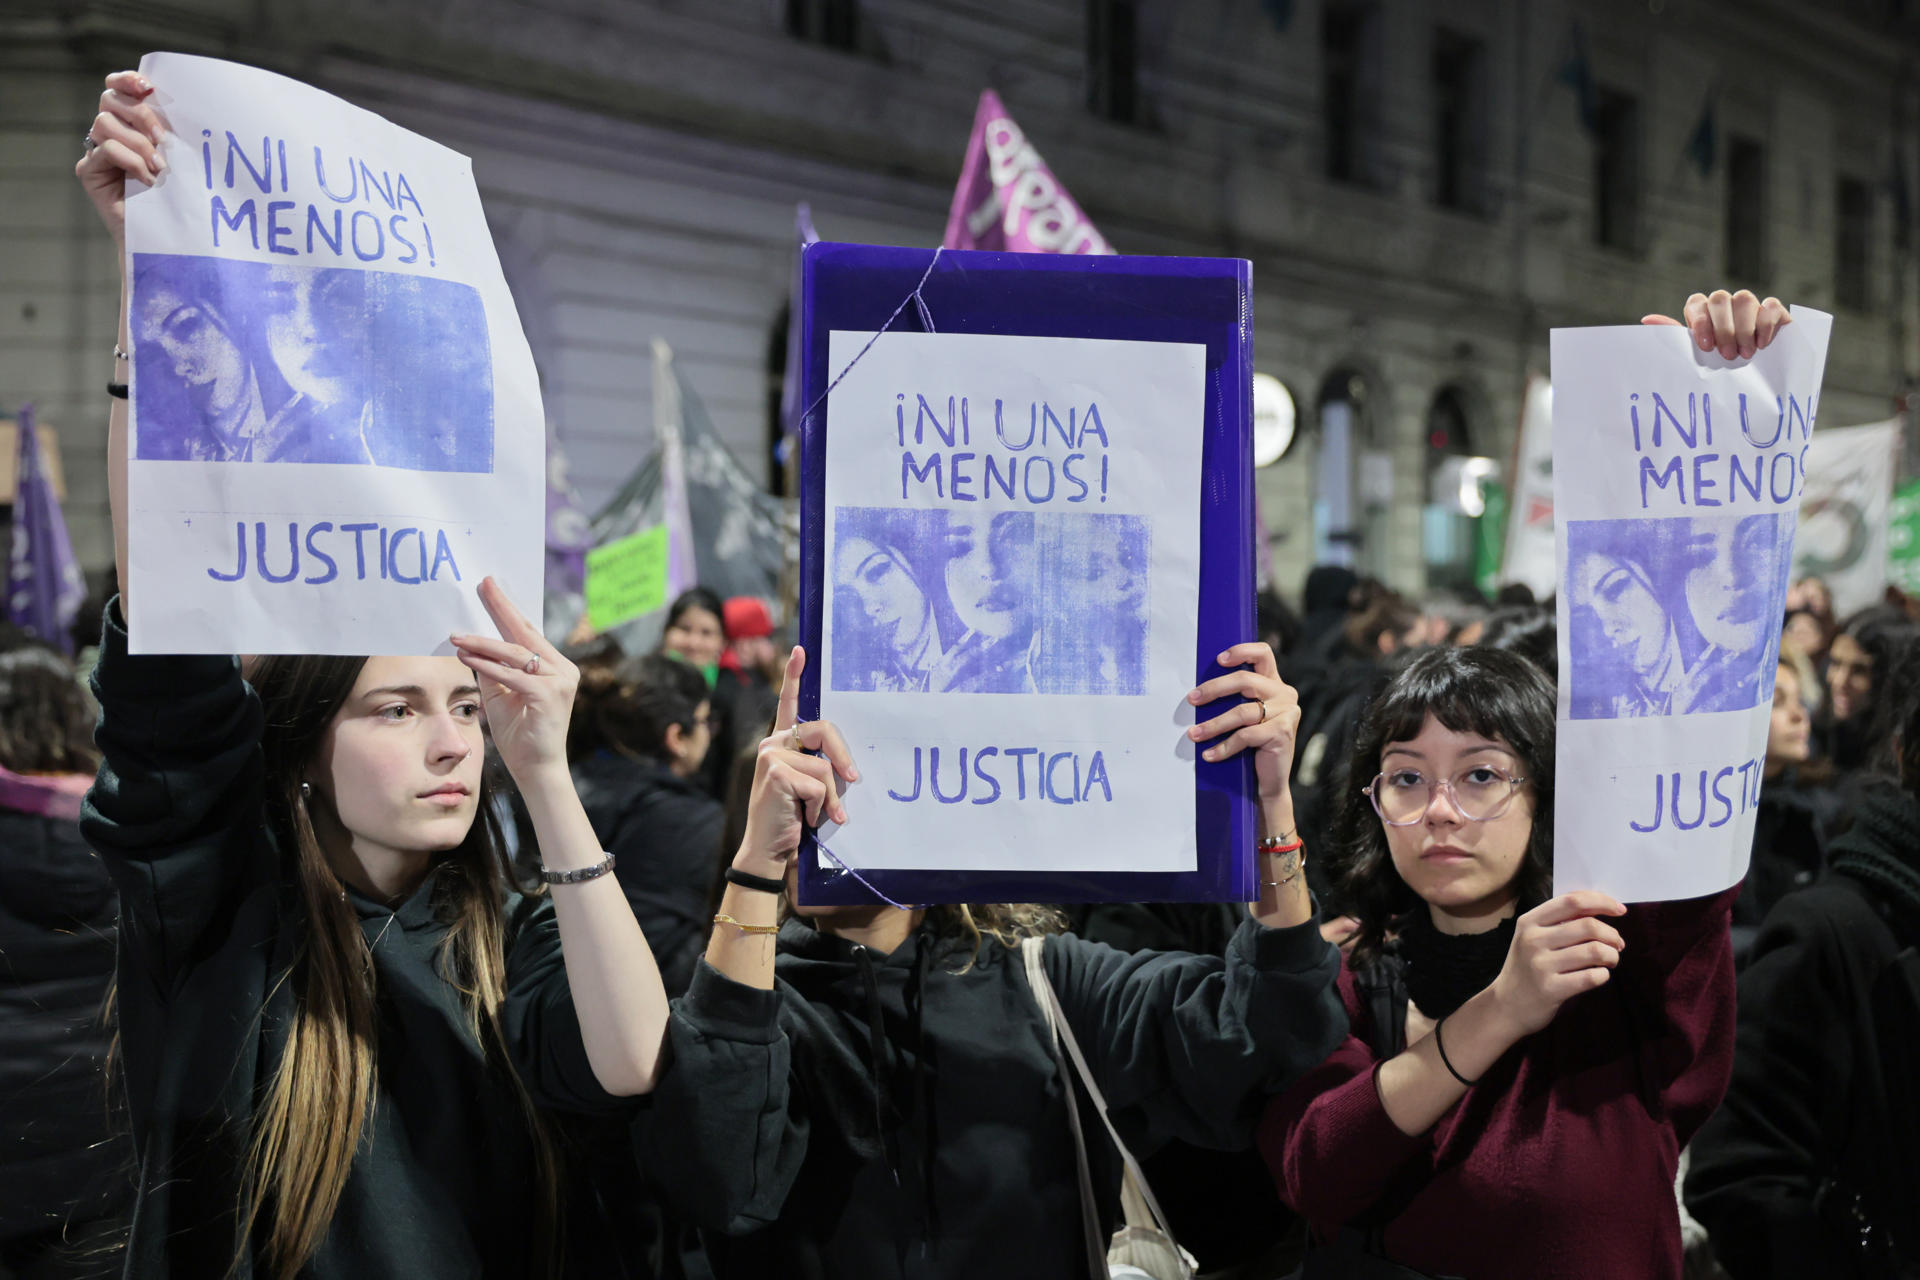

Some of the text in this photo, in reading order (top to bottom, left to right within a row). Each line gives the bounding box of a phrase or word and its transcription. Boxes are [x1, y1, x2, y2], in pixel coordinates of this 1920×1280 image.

[312, 146, 425, 218] UNA
[210, 194, 437, 269] MENOS!
[993, 398, 1109, 452] UNA
[901, 450, 1110, 505] MENOS!
[1639, 444, 1809, 508] MENOS
[207, 521, 462, 585] JUSTICIA
[887, 746, 1113, 806] JUSTICIA
[1629, 755, 1766, 833] JUSTIC
